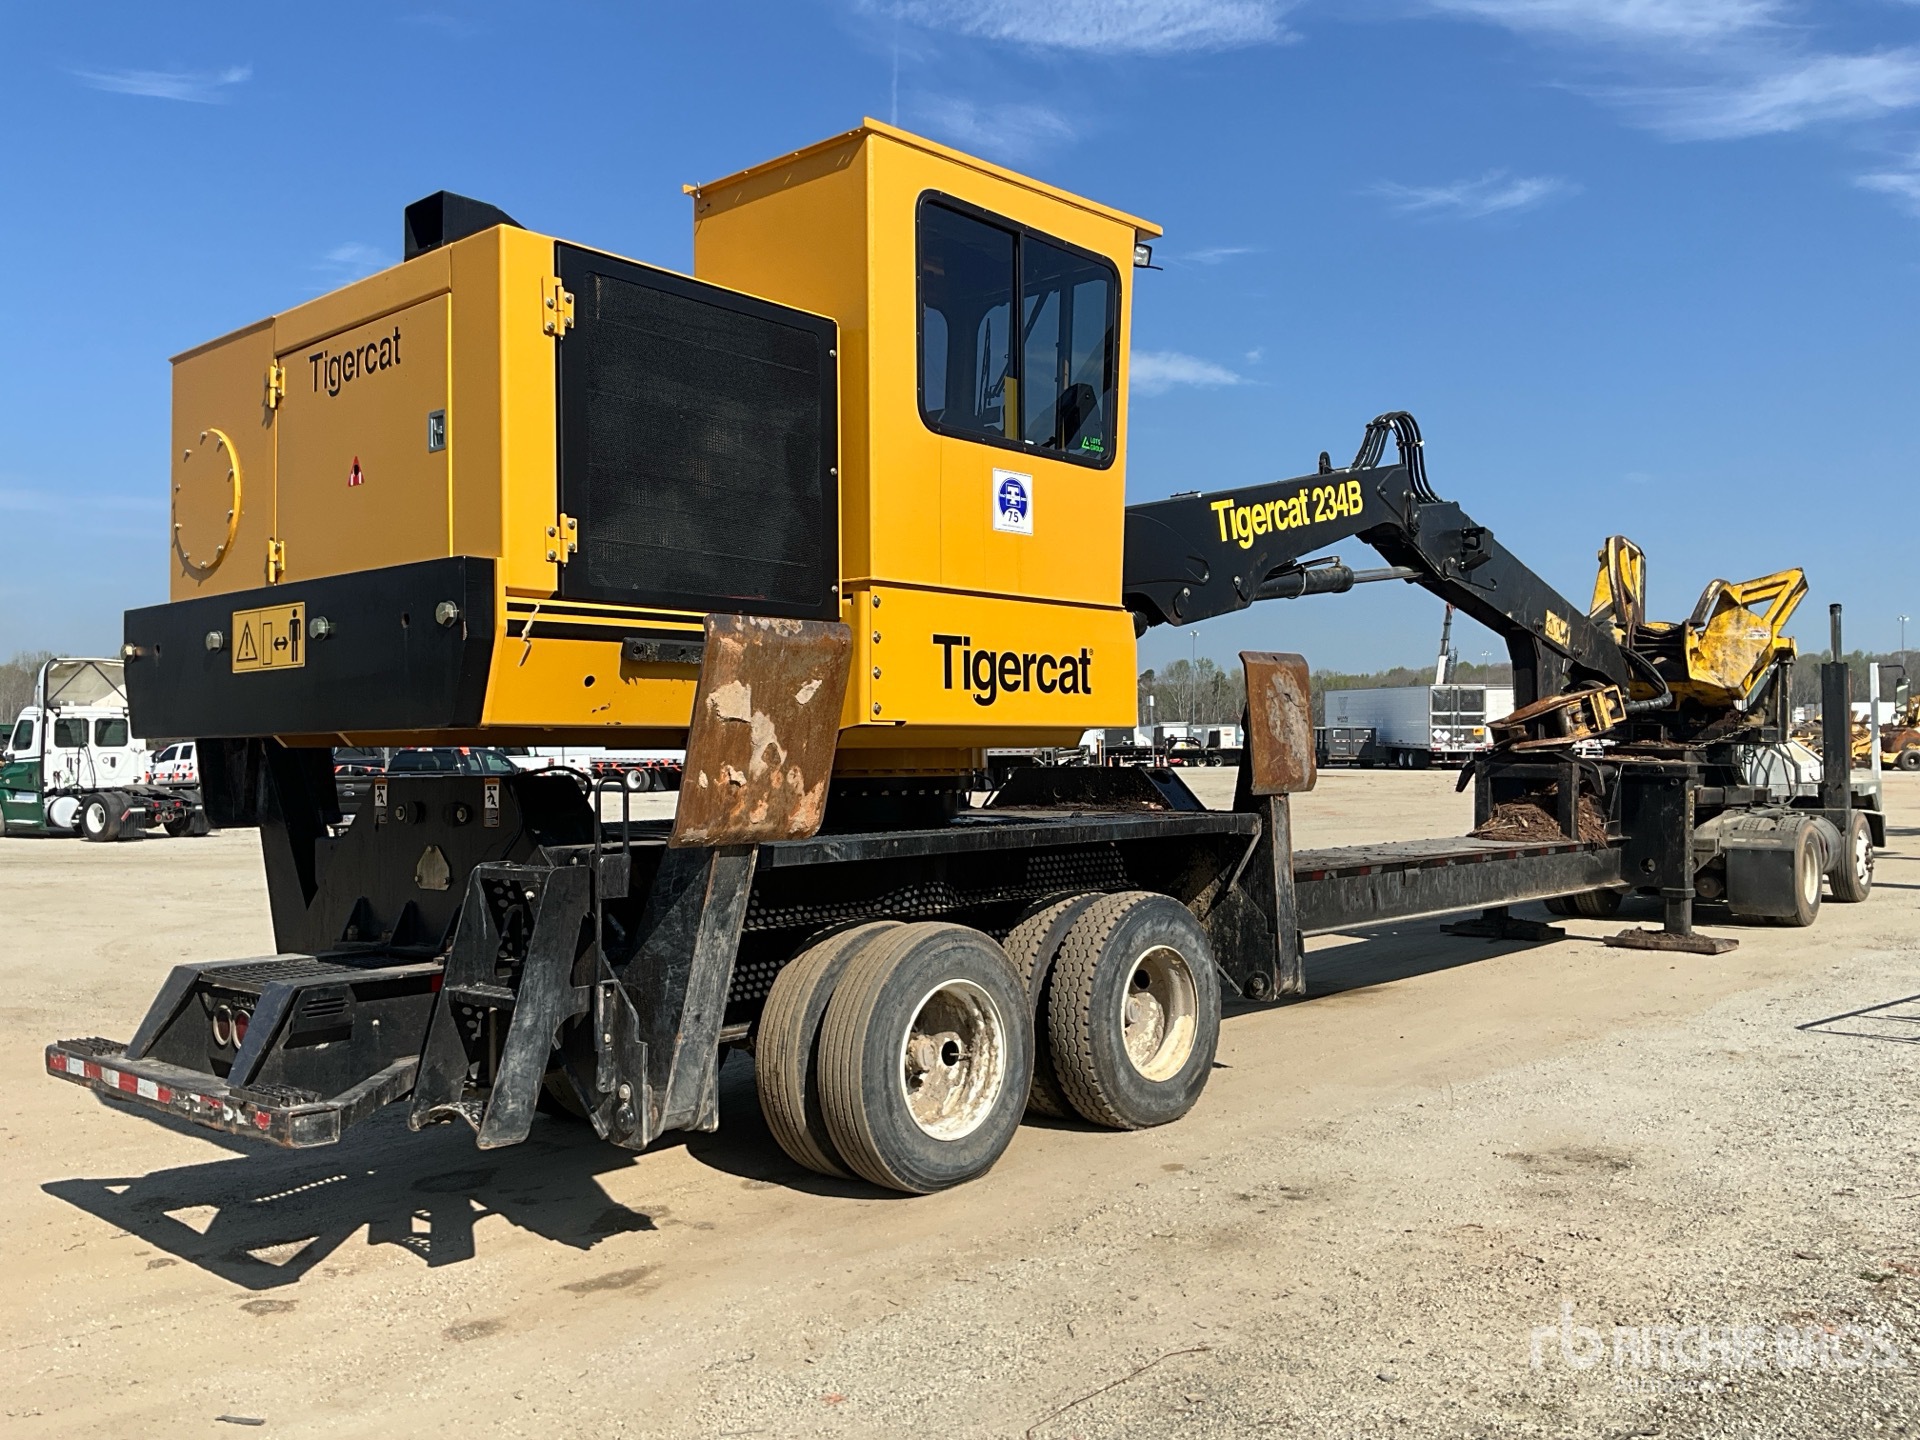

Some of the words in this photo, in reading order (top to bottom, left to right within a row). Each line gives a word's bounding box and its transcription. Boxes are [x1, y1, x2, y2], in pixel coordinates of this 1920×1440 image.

[309, 326, 401, 397] Tigercat
[1008, 510, 1019, 523] 75
[1210, 488, 1310, 549] Tigercat
[1312, 480, 1363, 523] 234B
[932, 633, 1092, 706] Tigercat
